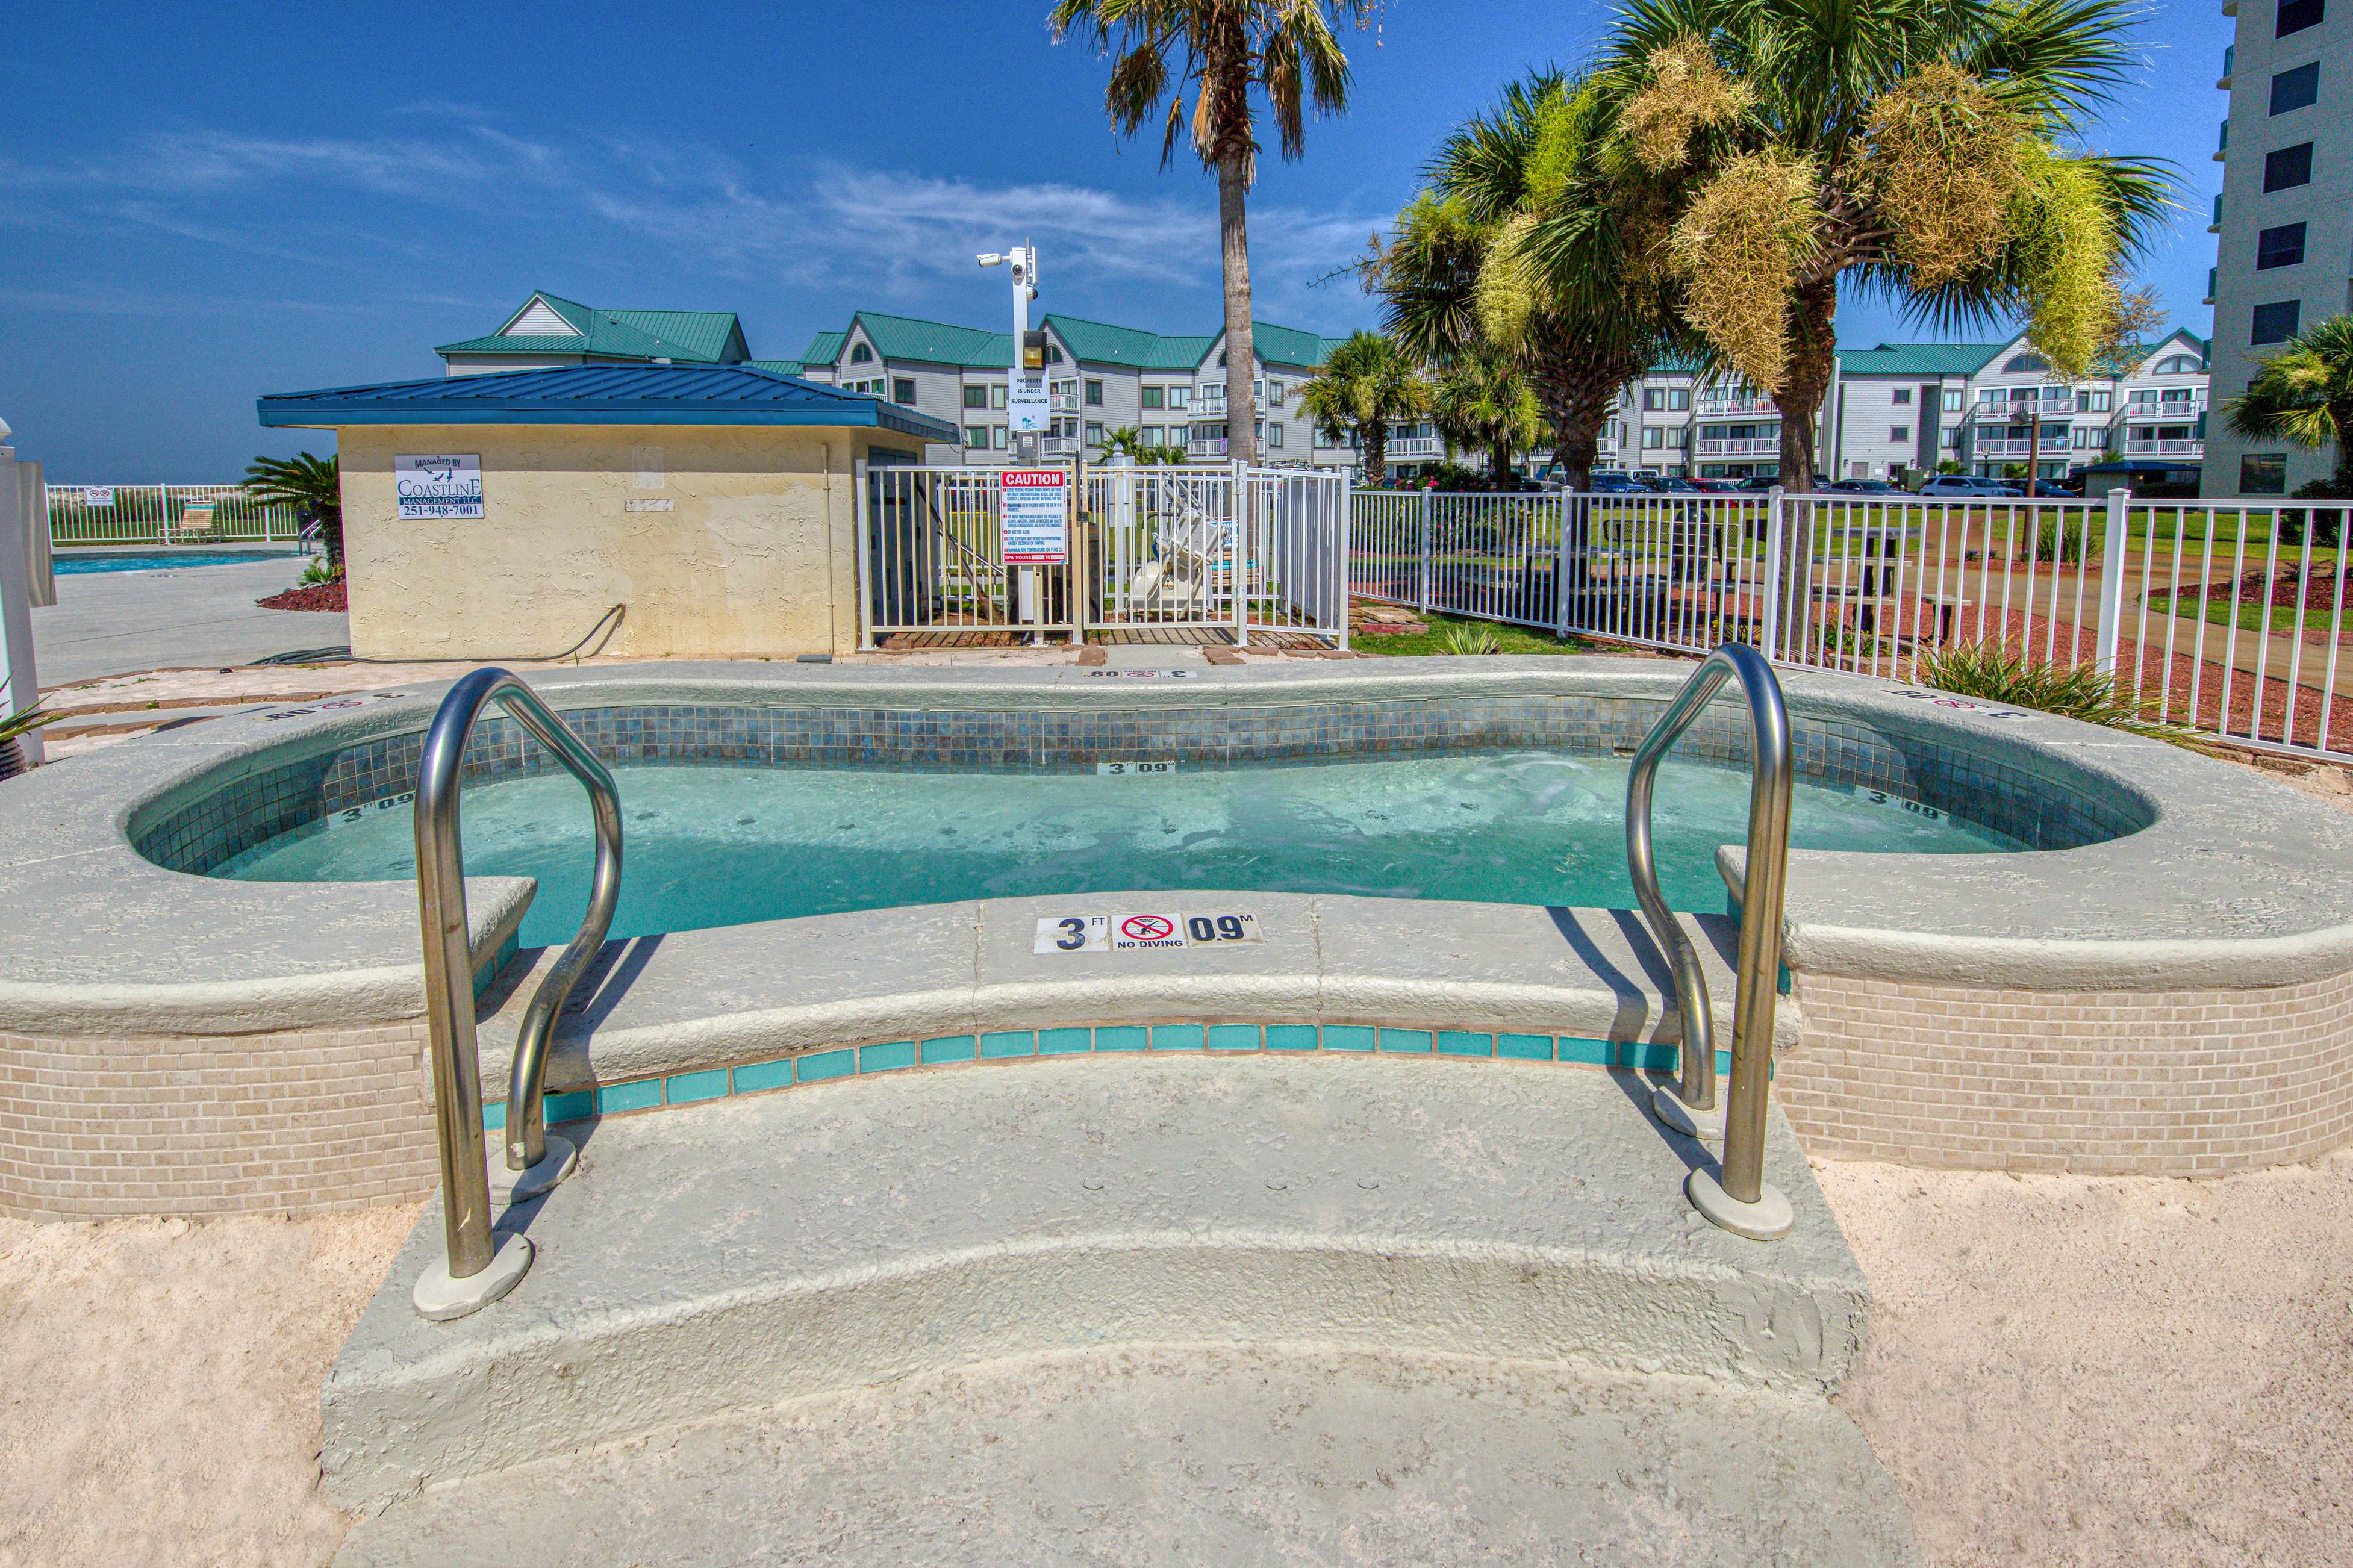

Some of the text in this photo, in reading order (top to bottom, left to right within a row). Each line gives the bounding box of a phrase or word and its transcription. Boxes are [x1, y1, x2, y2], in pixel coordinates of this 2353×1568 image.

[415, 459, 461, 468] MANAGED BY
[1006, 474, 1059, 485] CAUTION
[398, 479, 481, 496] COASTLINE
[404, 505, 478, 515] 251-948-7001
[1109, 763, 1125, 774] 3
[1868, 791, 1887, 805] 3
[342, 808, 362, 823] 3
[1056, 917, 1105, 950] 3 FT
[1188, 916, 1245, 942] 0.9
[1117, 939, 1183, 948] NO DIVING
